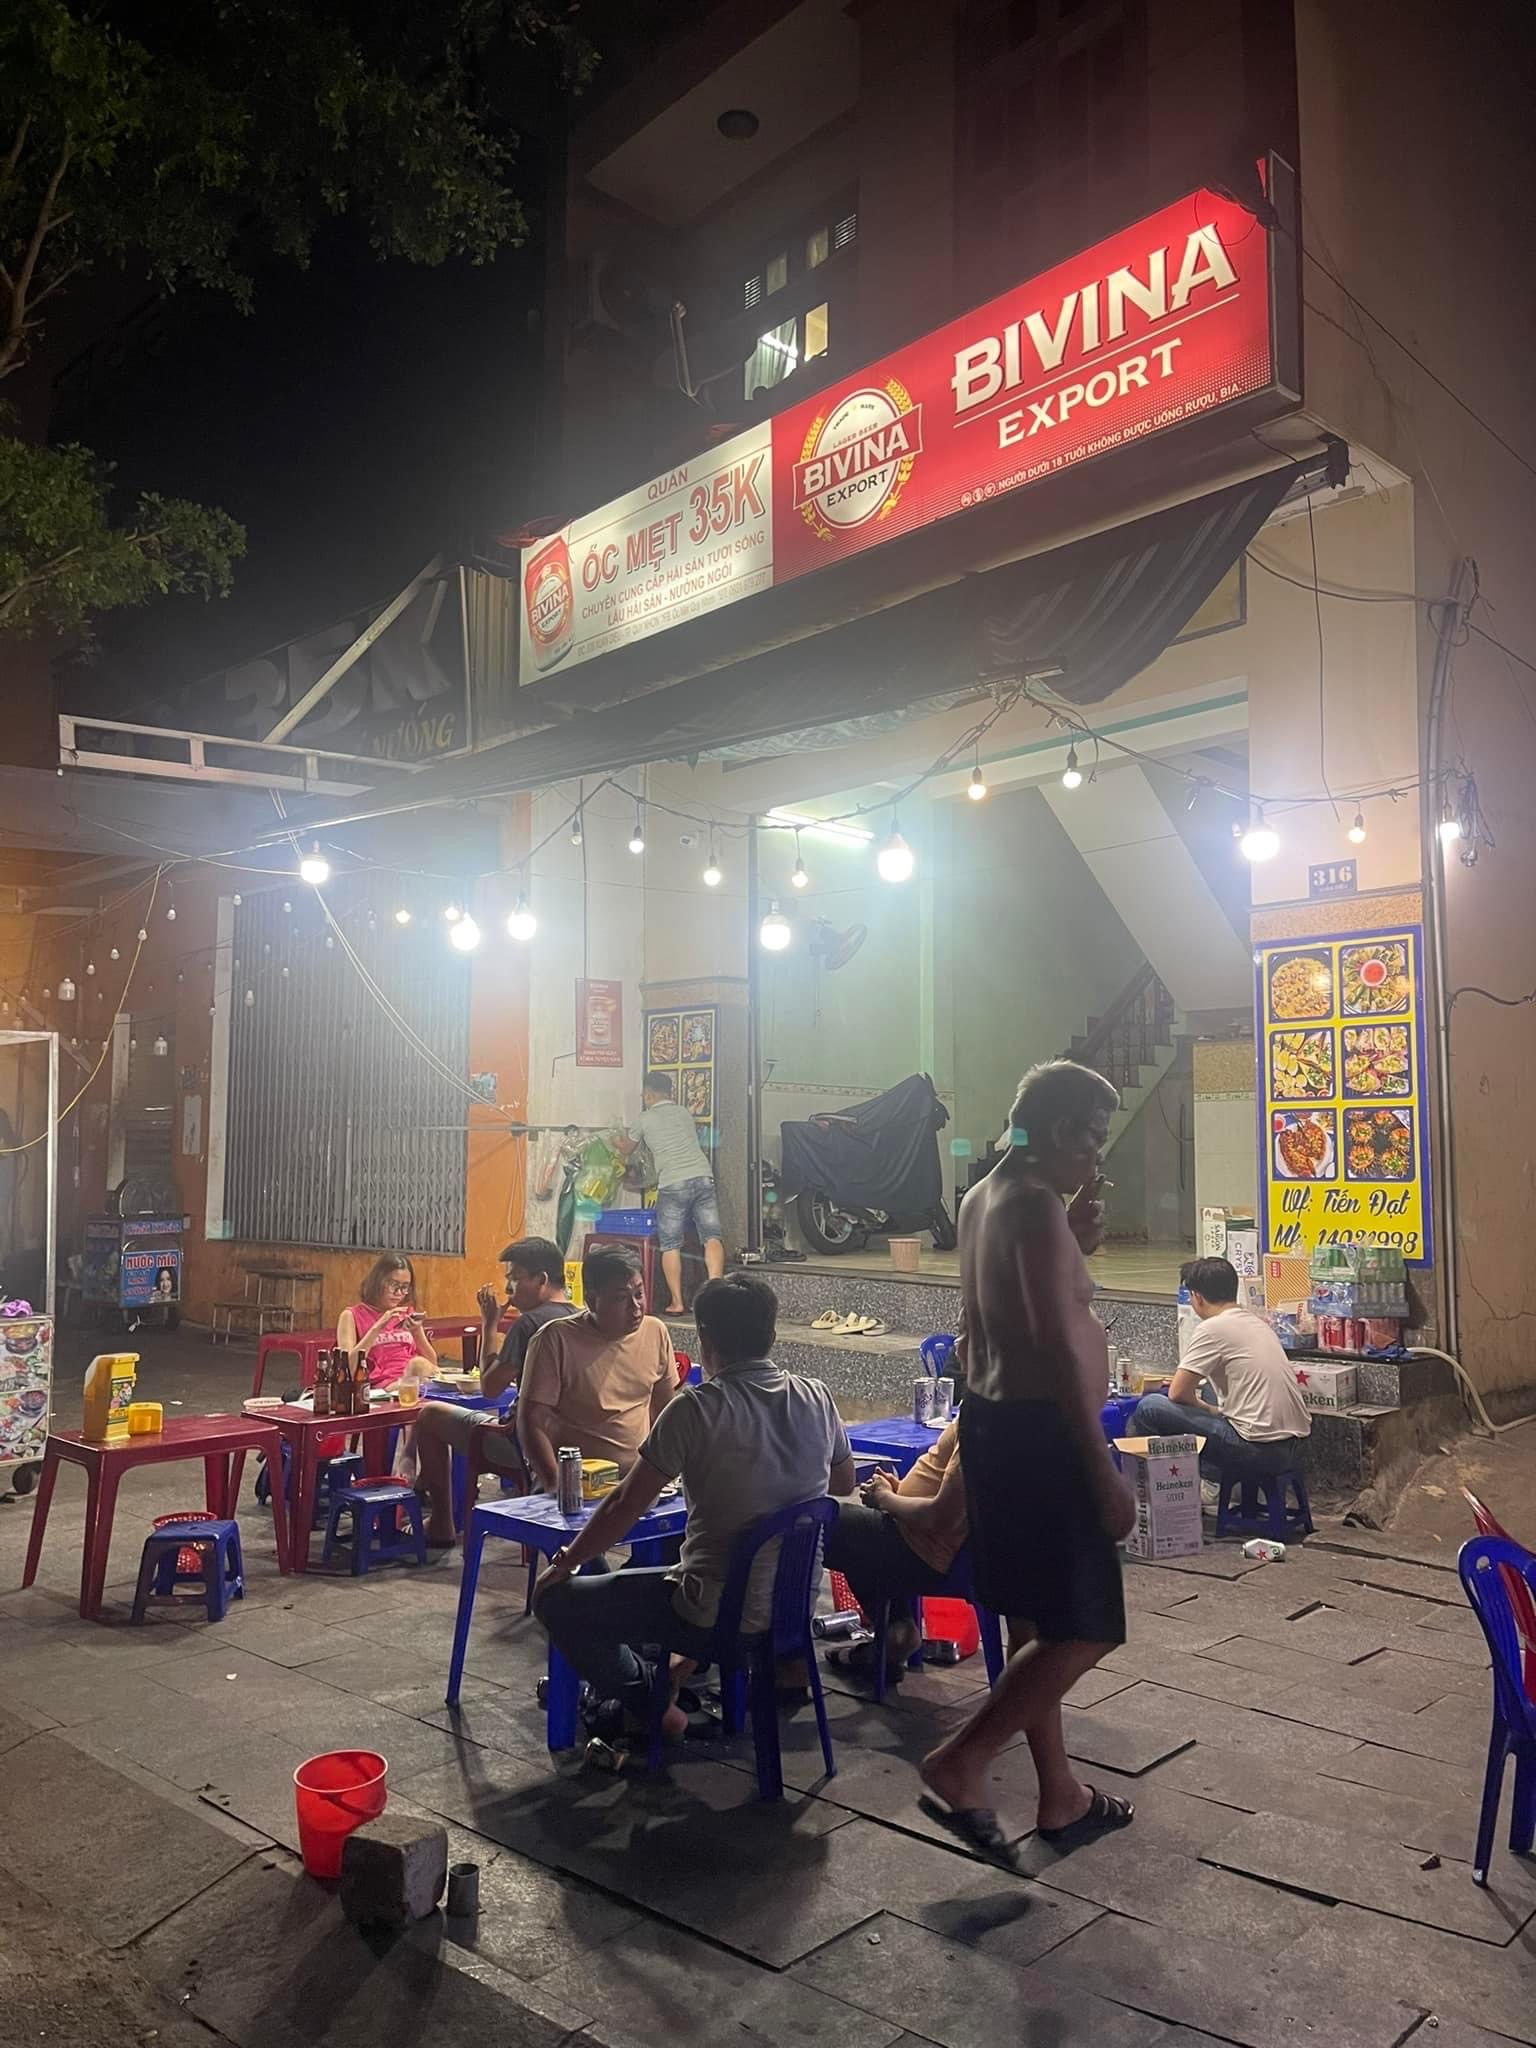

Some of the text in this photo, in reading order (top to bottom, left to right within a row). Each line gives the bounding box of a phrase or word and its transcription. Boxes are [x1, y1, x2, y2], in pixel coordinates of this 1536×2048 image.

[951, 222, 1240, 416] BIVINA
[997, 337, 1182, 449] EXPORT
[803, 422, 910, 496] BIVINA
[1052, 456, 1063, 468] 18
[1087, 432, 1122, 454] KHÔNG
[826, 469, 889, 507] EXPORT
[582, 453, 766, 592] ỐC MẸT 35K
[531, 584, 569, 624] BIVINA
[618, 583, 644, 605] CUNG
[1313, 866, 1353, 886] 316
[1324, 1188, 1361, 1213] Tiến
[1369, 1188, 1411, 1219] Đạt
[1155, 1480, 1193, 1492] Heineken
